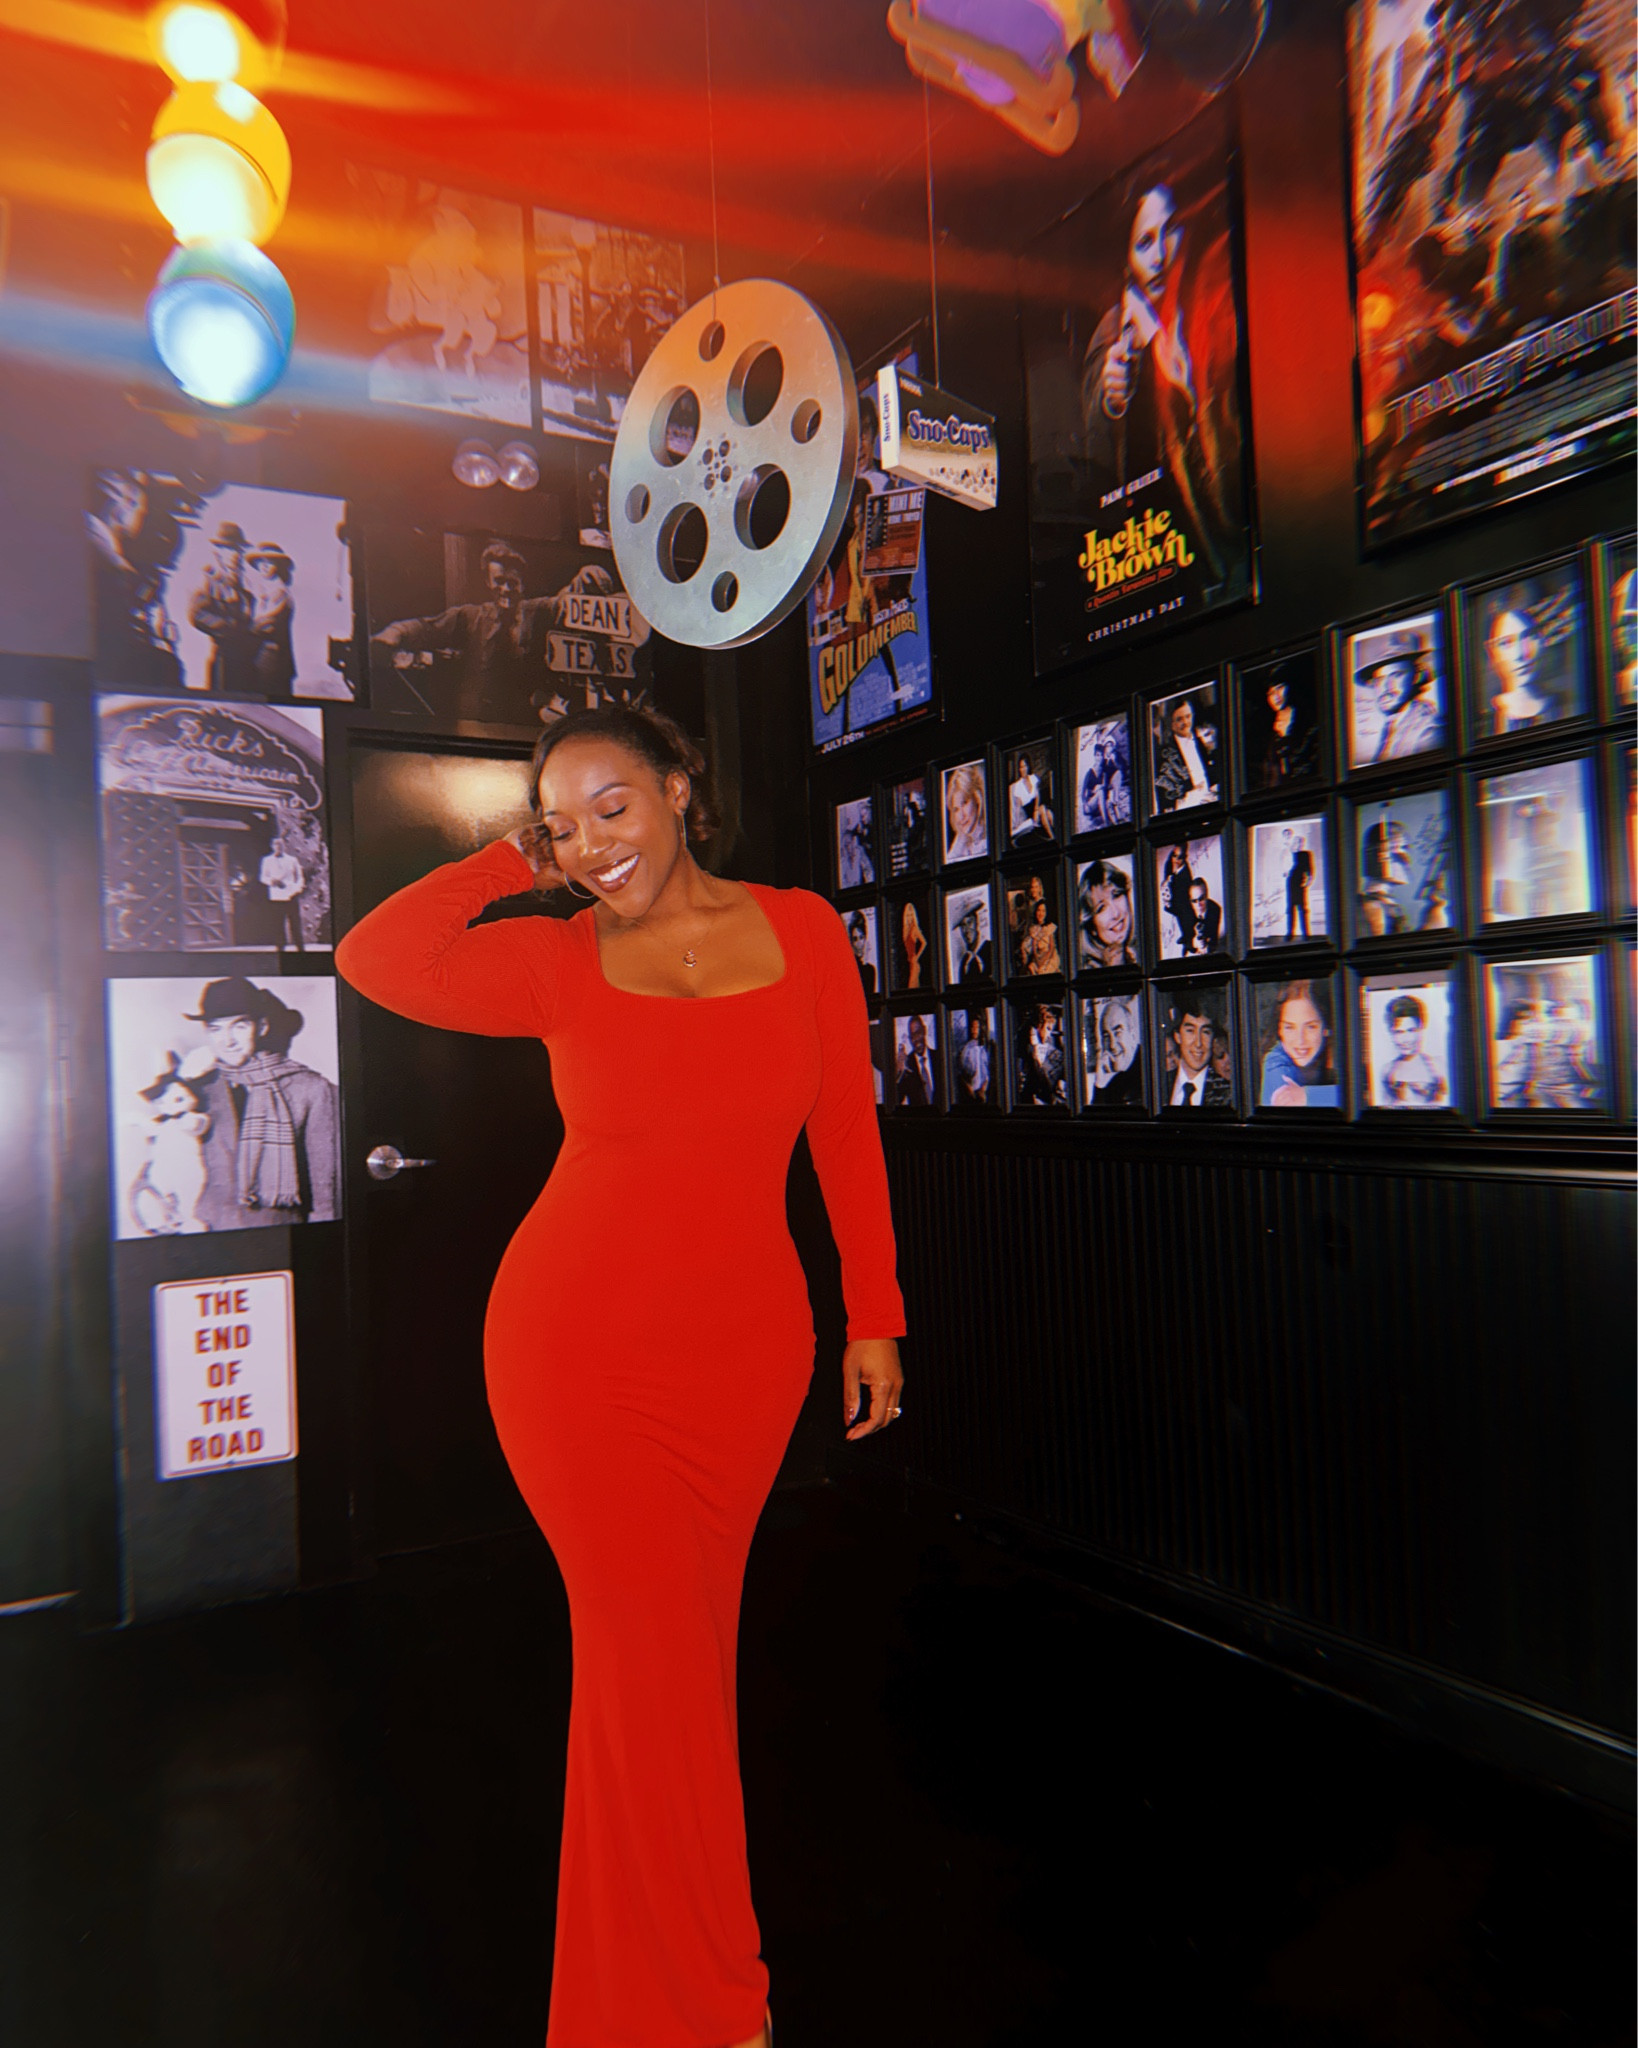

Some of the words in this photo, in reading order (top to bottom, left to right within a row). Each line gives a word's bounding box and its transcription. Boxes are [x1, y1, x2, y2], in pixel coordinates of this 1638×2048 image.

[908, 409, 992, 454] Sno-Caps
[1078, 508, 1172, 569] Jackie
[1087, 529, 1195, 592] Brown
[570, 598, 619, 630] DEAN
[1087, 608, 1155, 642] CHRISTMAS
[1159, 596, 1186, 614] DAY
[562, 639, 627, 673] TEXS
[818, 611, 918, 715] GOLDMEMBER
[176, 717, 265, 759] Rick's
[821, 733, 843, 754] JULY
[194, 1288, 250, 1317] THE
[194, 1324, 251, 1354] END
[207, 1360, 242, 1389] OF
[197, 1394, 253, 1425] THE
[187, 1427, 264, 1463] ROAD
